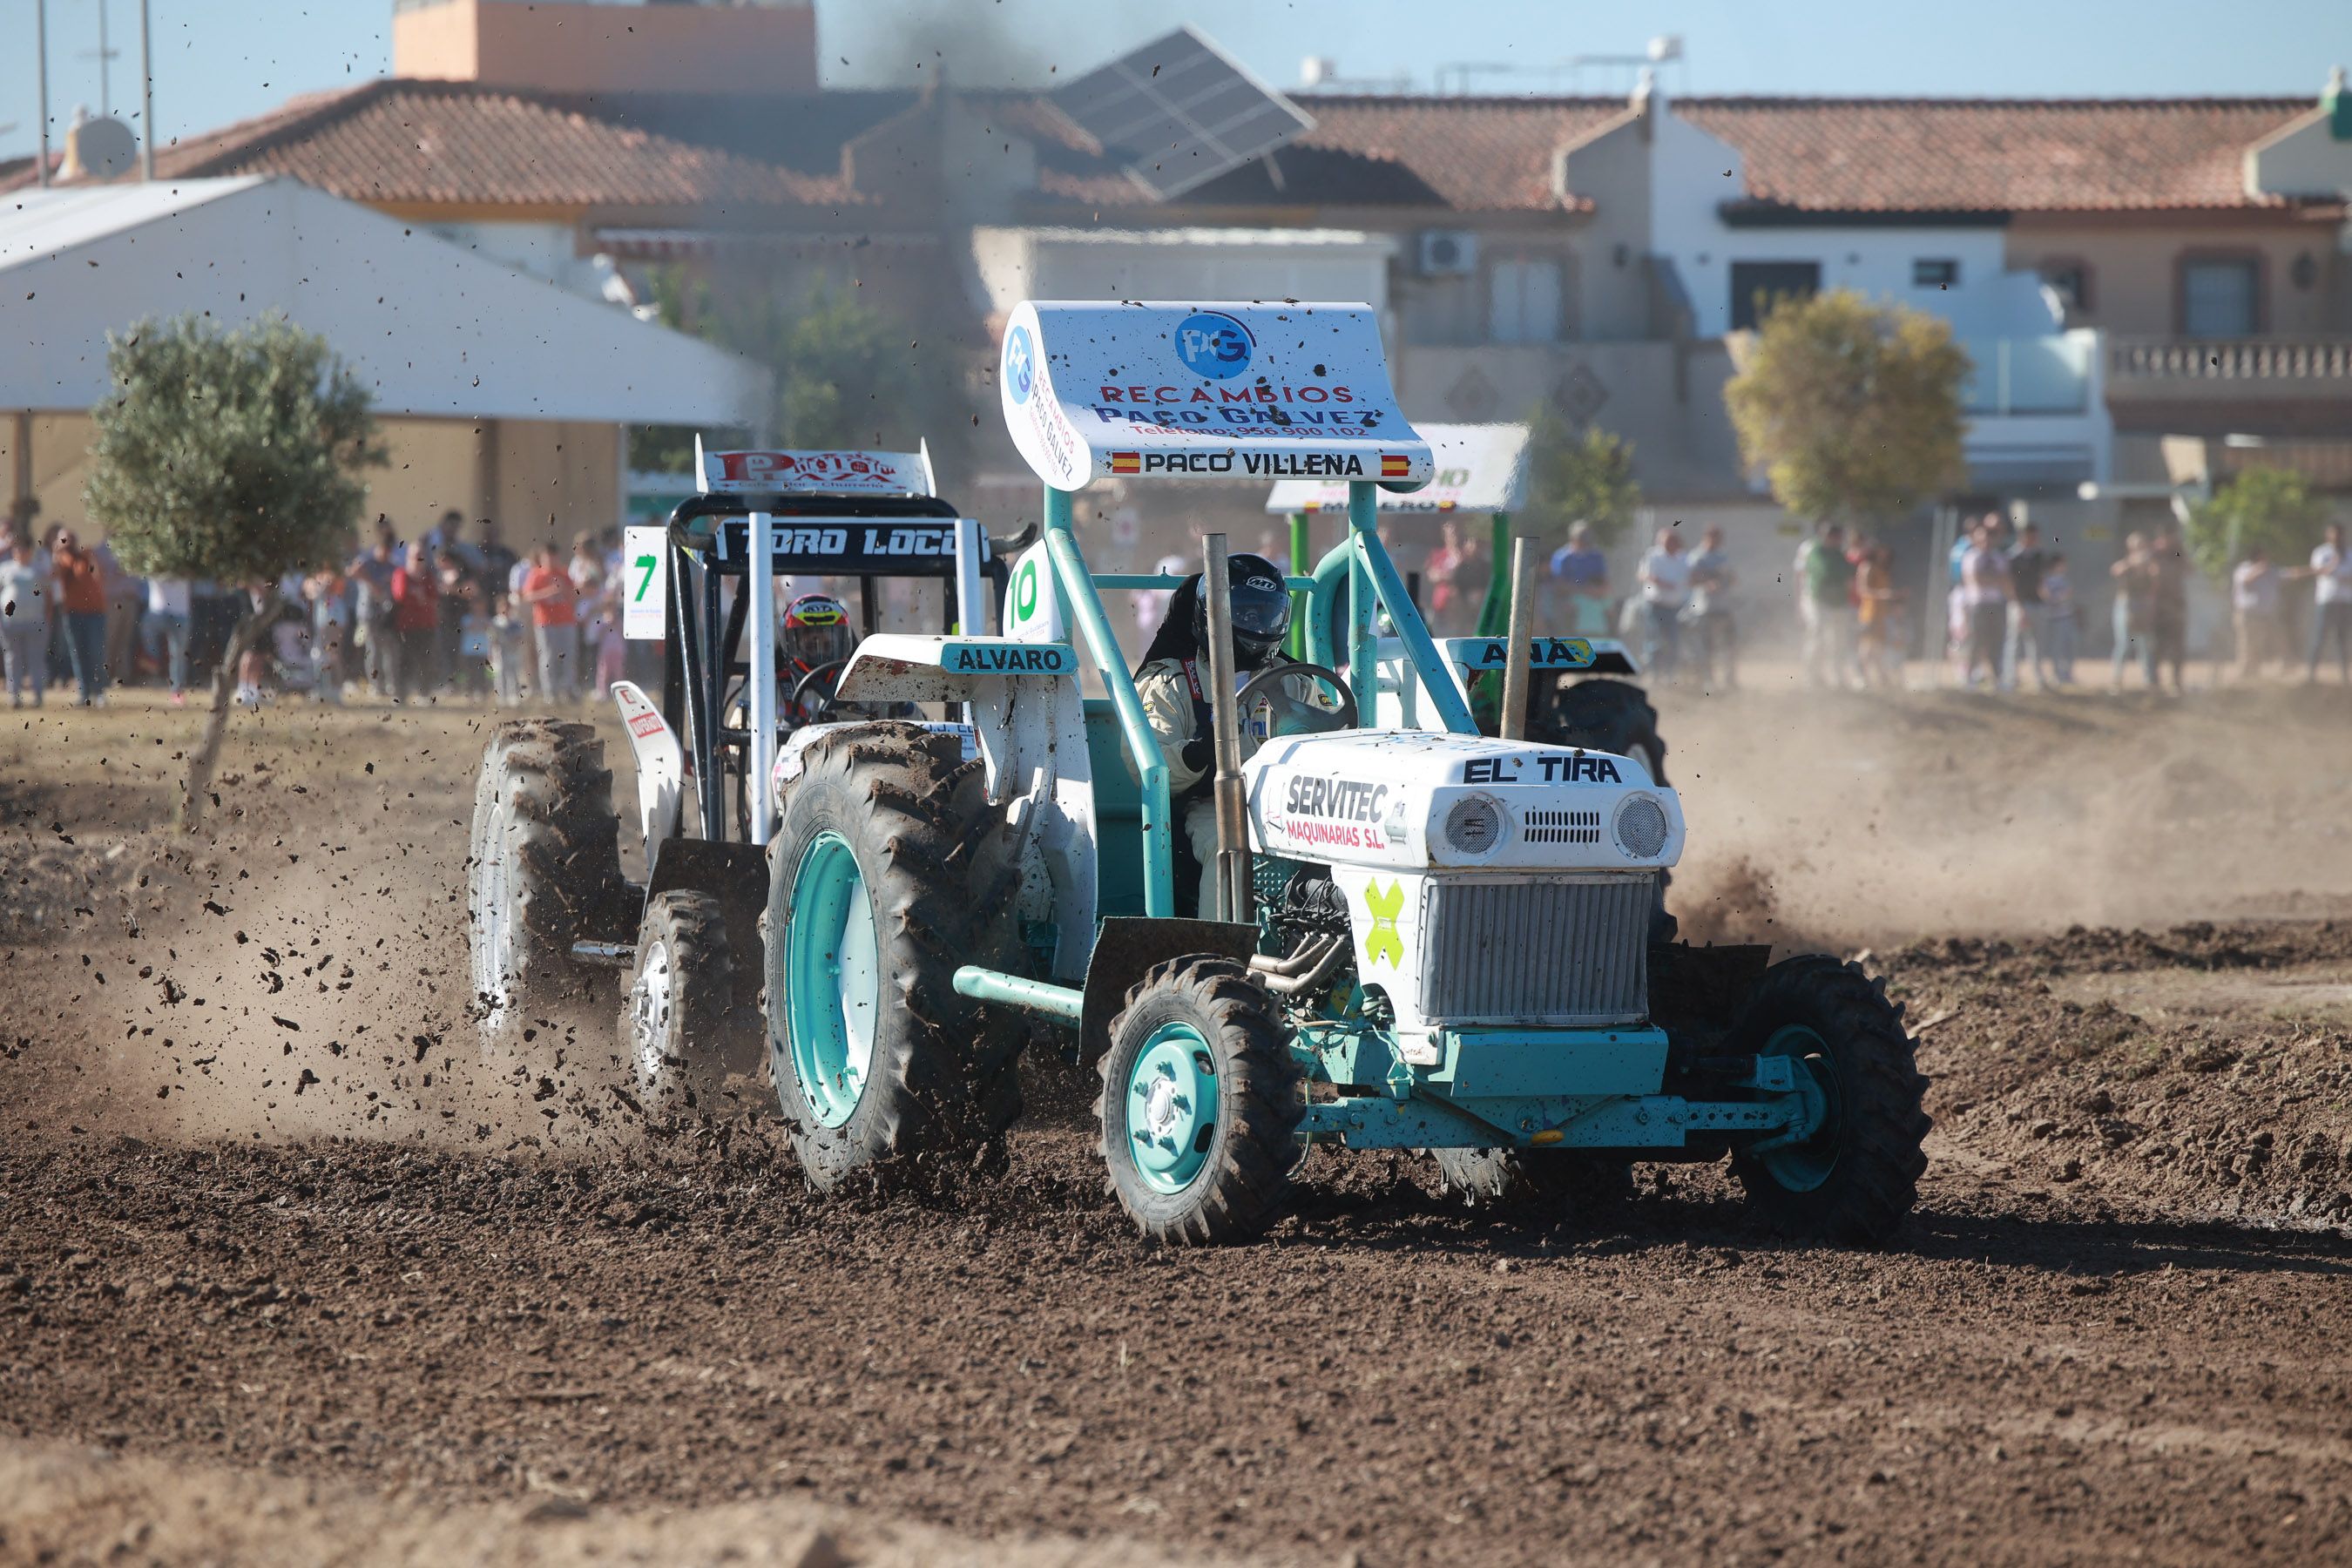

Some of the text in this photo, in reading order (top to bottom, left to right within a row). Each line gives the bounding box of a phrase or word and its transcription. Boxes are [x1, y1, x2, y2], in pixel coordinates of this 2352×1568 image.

[1100, 386, 1354, 403] RECAMBIOS
[1038, 370, 1074, 454] RECAMBIOS
[1094, 407, 1208, 423] PACO
[1236, 427, 1278, 436] 956
[1281, 427, 1323, 436] 900
[1328, 427, 1369, 436] 102
[1145, 453, 1363, 476] PACO VILLENA
[634, 556, 657, 602] 7
[1010, 559, 1037, 631] 10
[958, 649, 1062, 670] ALVARO
[1463, 757, 1622, 783] EL TIRA
[1287, 774, 1389, 823] SERVITEC
[1286, 820, 1385, 849] MAQUINARIAS S.L.
